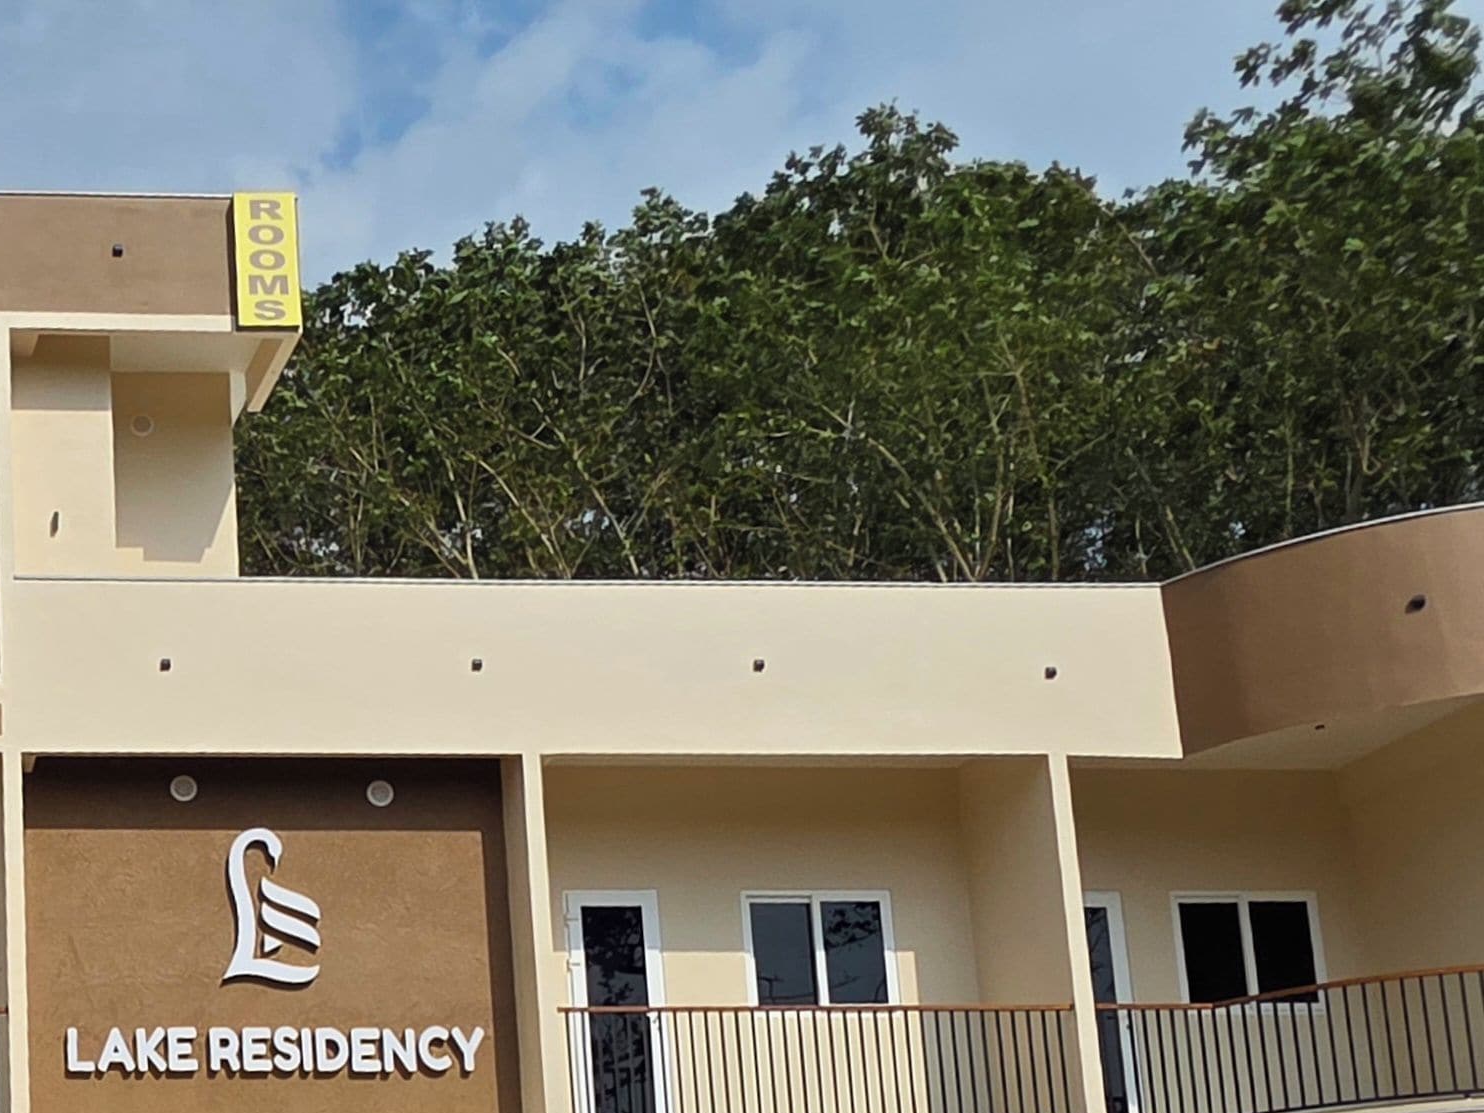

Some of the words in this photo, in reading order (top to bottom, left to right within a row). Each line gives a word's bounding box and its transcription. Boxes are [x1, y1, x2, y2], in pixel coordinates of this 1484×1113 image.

[248, 199, 289, 321] ROOMS
[67, 1026, 198, 1072] LAKE
[209, 1025, 485, 1072] RESIDENCY
